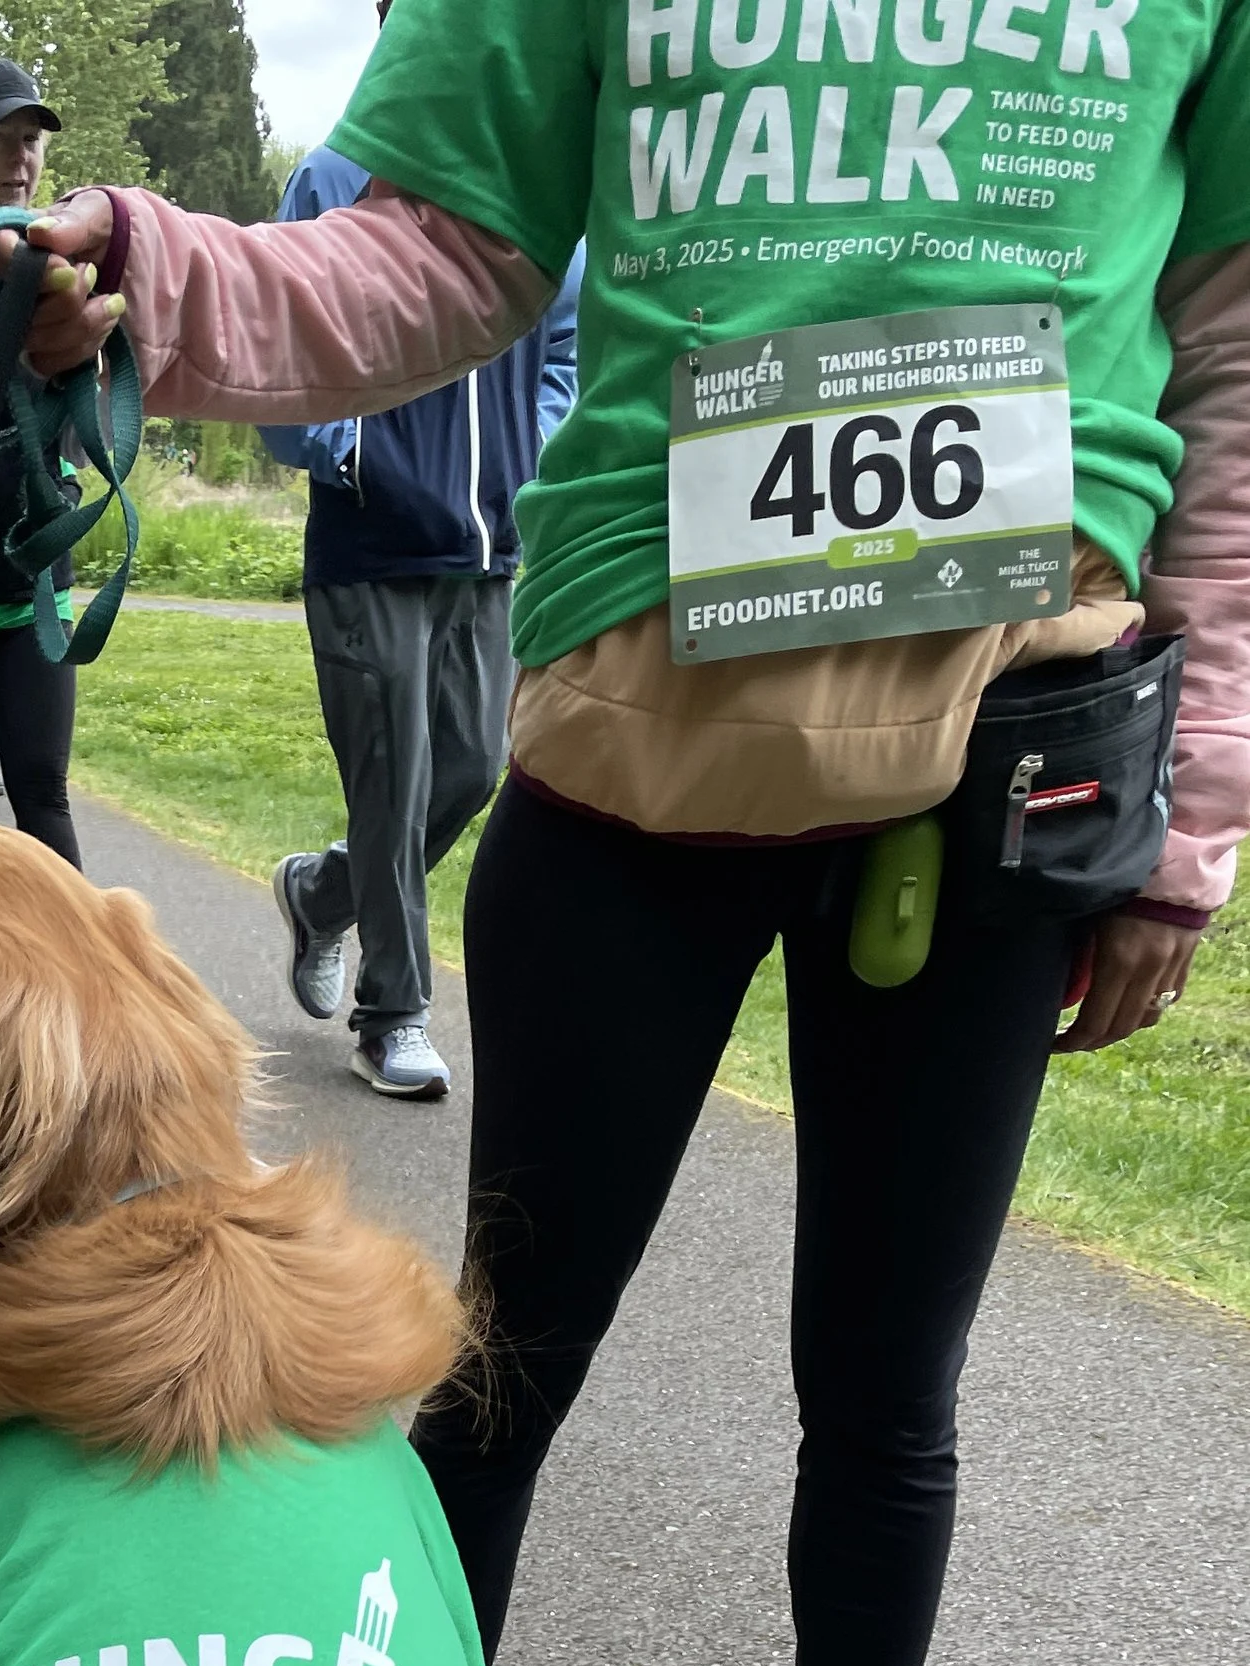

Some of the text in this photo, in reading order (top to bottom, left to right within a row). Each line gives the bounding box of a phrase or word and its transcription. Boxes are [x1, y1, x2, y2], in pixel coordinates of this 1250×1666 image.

[991, 90, 1128, 122] TAKING STEPS
[630, 85, 973, 220] WALK
[986, 121, 1115, 152] TO FEED OUR
[981, 153, 1096, 182] NEIGHBORS
[976, 184, 1055, 209] IN NEED
[612, 231, 1088, 280] May 3, 2025 Emergency Food Network
[818, 335, 1026, 373] TAKING STEPS TO FEED
[695, 361, 783, 398] HUNGER
[818, 358, 1043, 399] OUR NEIGHBORS IN NEED
[696, 388, 757, 420] WALK
[750, 404, 984, 538] 466
[853, 537, 895, 558] 2025
[1019, 548, 1041, 560] THE
[998, 560, 1059, 576] MIKE TUCCI
[1010, 575, 1047, 589] FAMILY
[687, 581, 884, 632] EFOODNET.ORG
